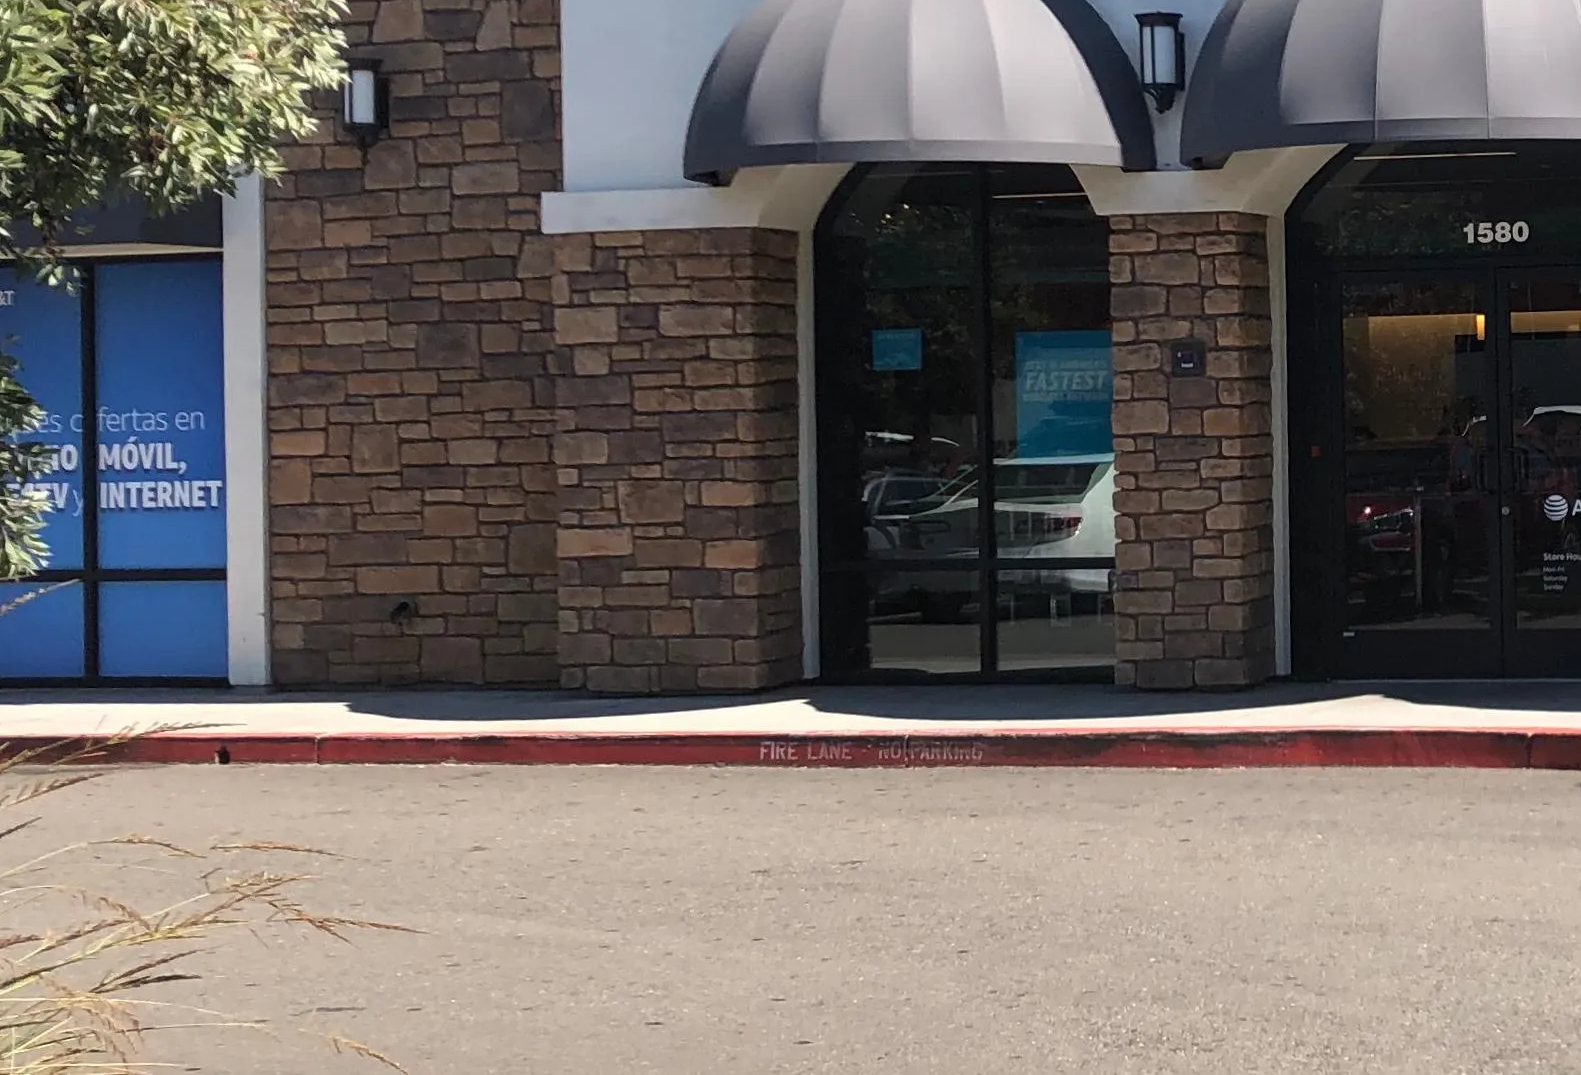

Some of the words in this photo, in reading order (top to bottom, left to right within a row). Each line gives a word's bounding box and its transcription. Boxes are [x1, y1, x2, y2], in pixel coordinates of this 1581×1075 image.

[1463, 220, 1530, 244] 1580
[1026, 371, 1108, 390] FASTEST
[175, 410, 206, 431] en
[99, 436, 187, 475] MÓVIL,
[100, 480, 223, 509] INTERNET
[1543, 552, 1565, 561] Store
[760, 741, 799, 760] FIRE
[807, 742, 852, 759] LANE
